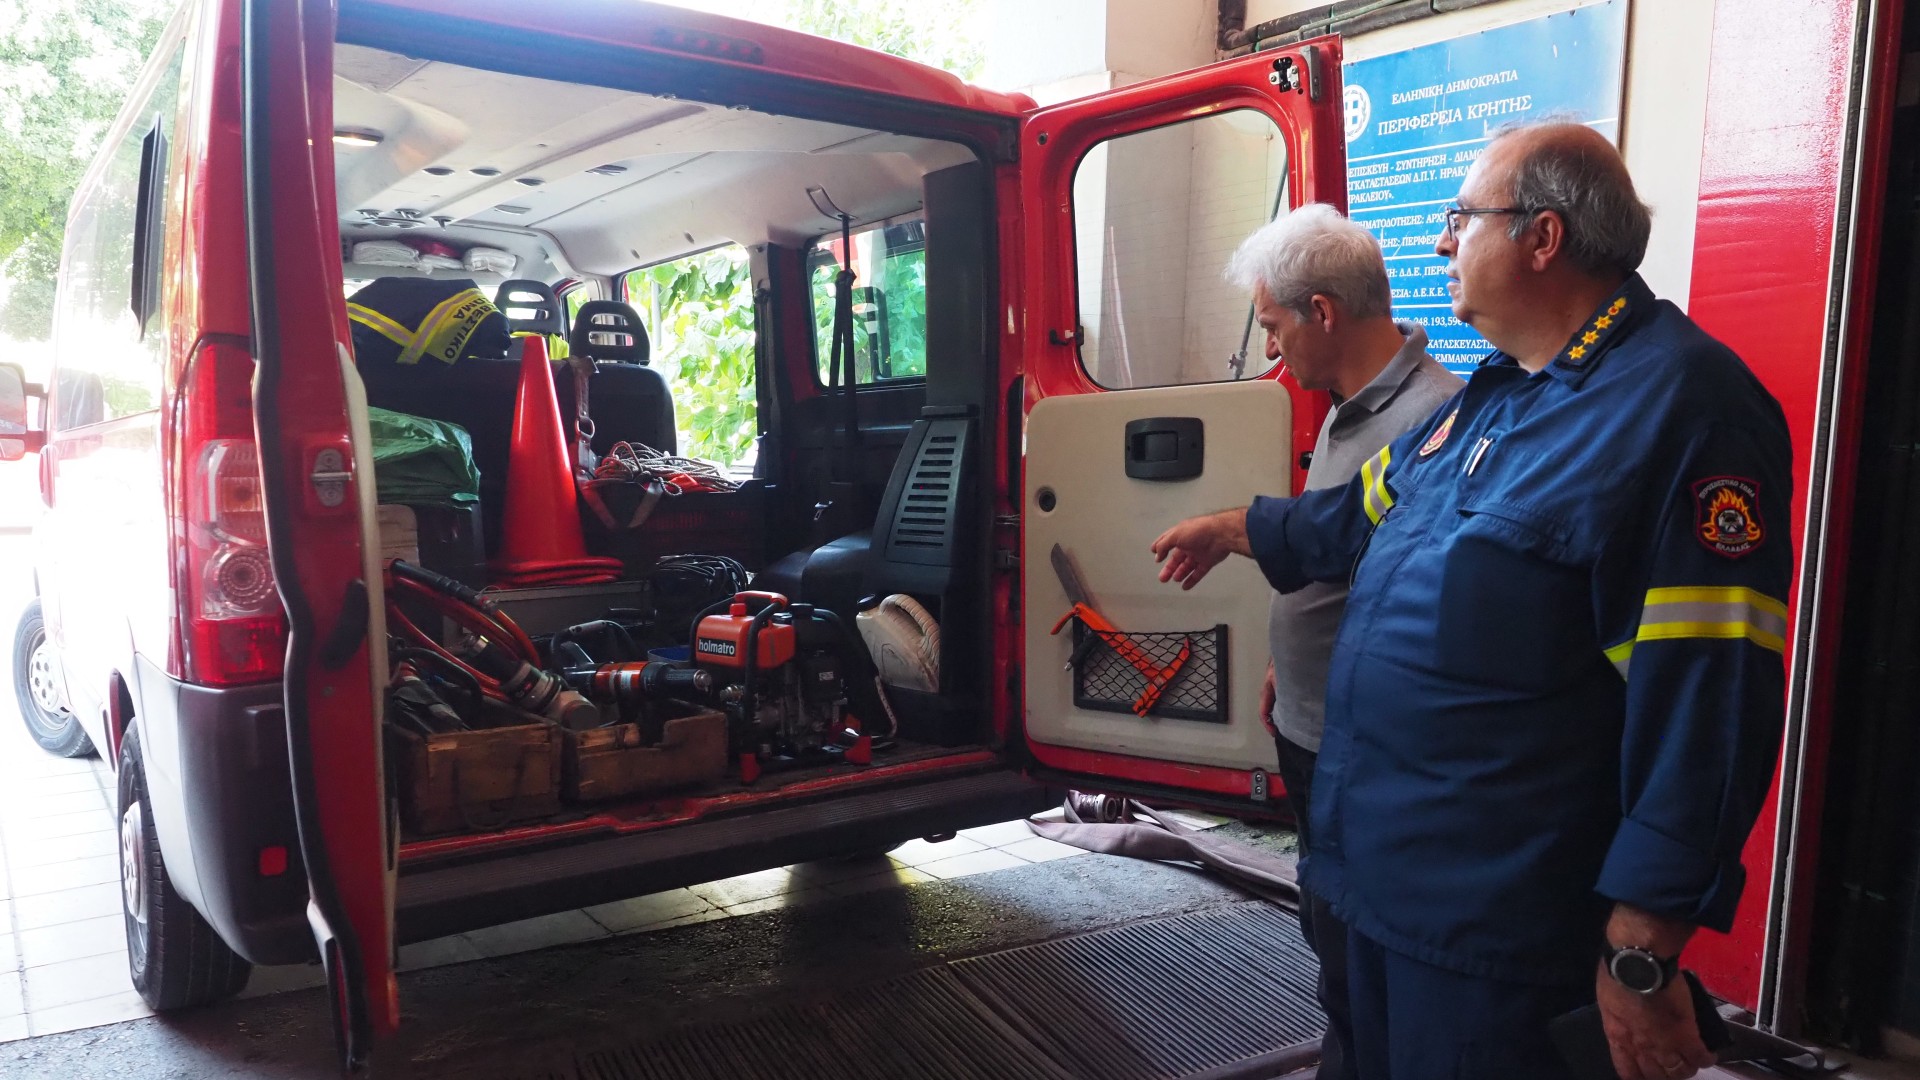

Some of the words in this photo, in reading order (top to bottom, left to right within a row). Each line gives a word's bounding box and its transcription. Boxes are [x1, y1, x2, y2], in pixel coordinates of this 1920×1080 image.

[1391, 84, 1444, 105] ΕΛΛΗΝΙΚΗ
[1445, 69, 1519, 94] ΔΗΜΟΚΡΑΤΙΑ
[1378, 108, 1463, 136] ΠΕΡΙΦΕΡΕΙΑ
[1466, 95, 1532, 120] ΚΡΗΤΗΣ
[1395, 154, 1447, 172] ΣΥΝΤΗΡΗΣΗ
[698, 639, 735, 655] holmatro
